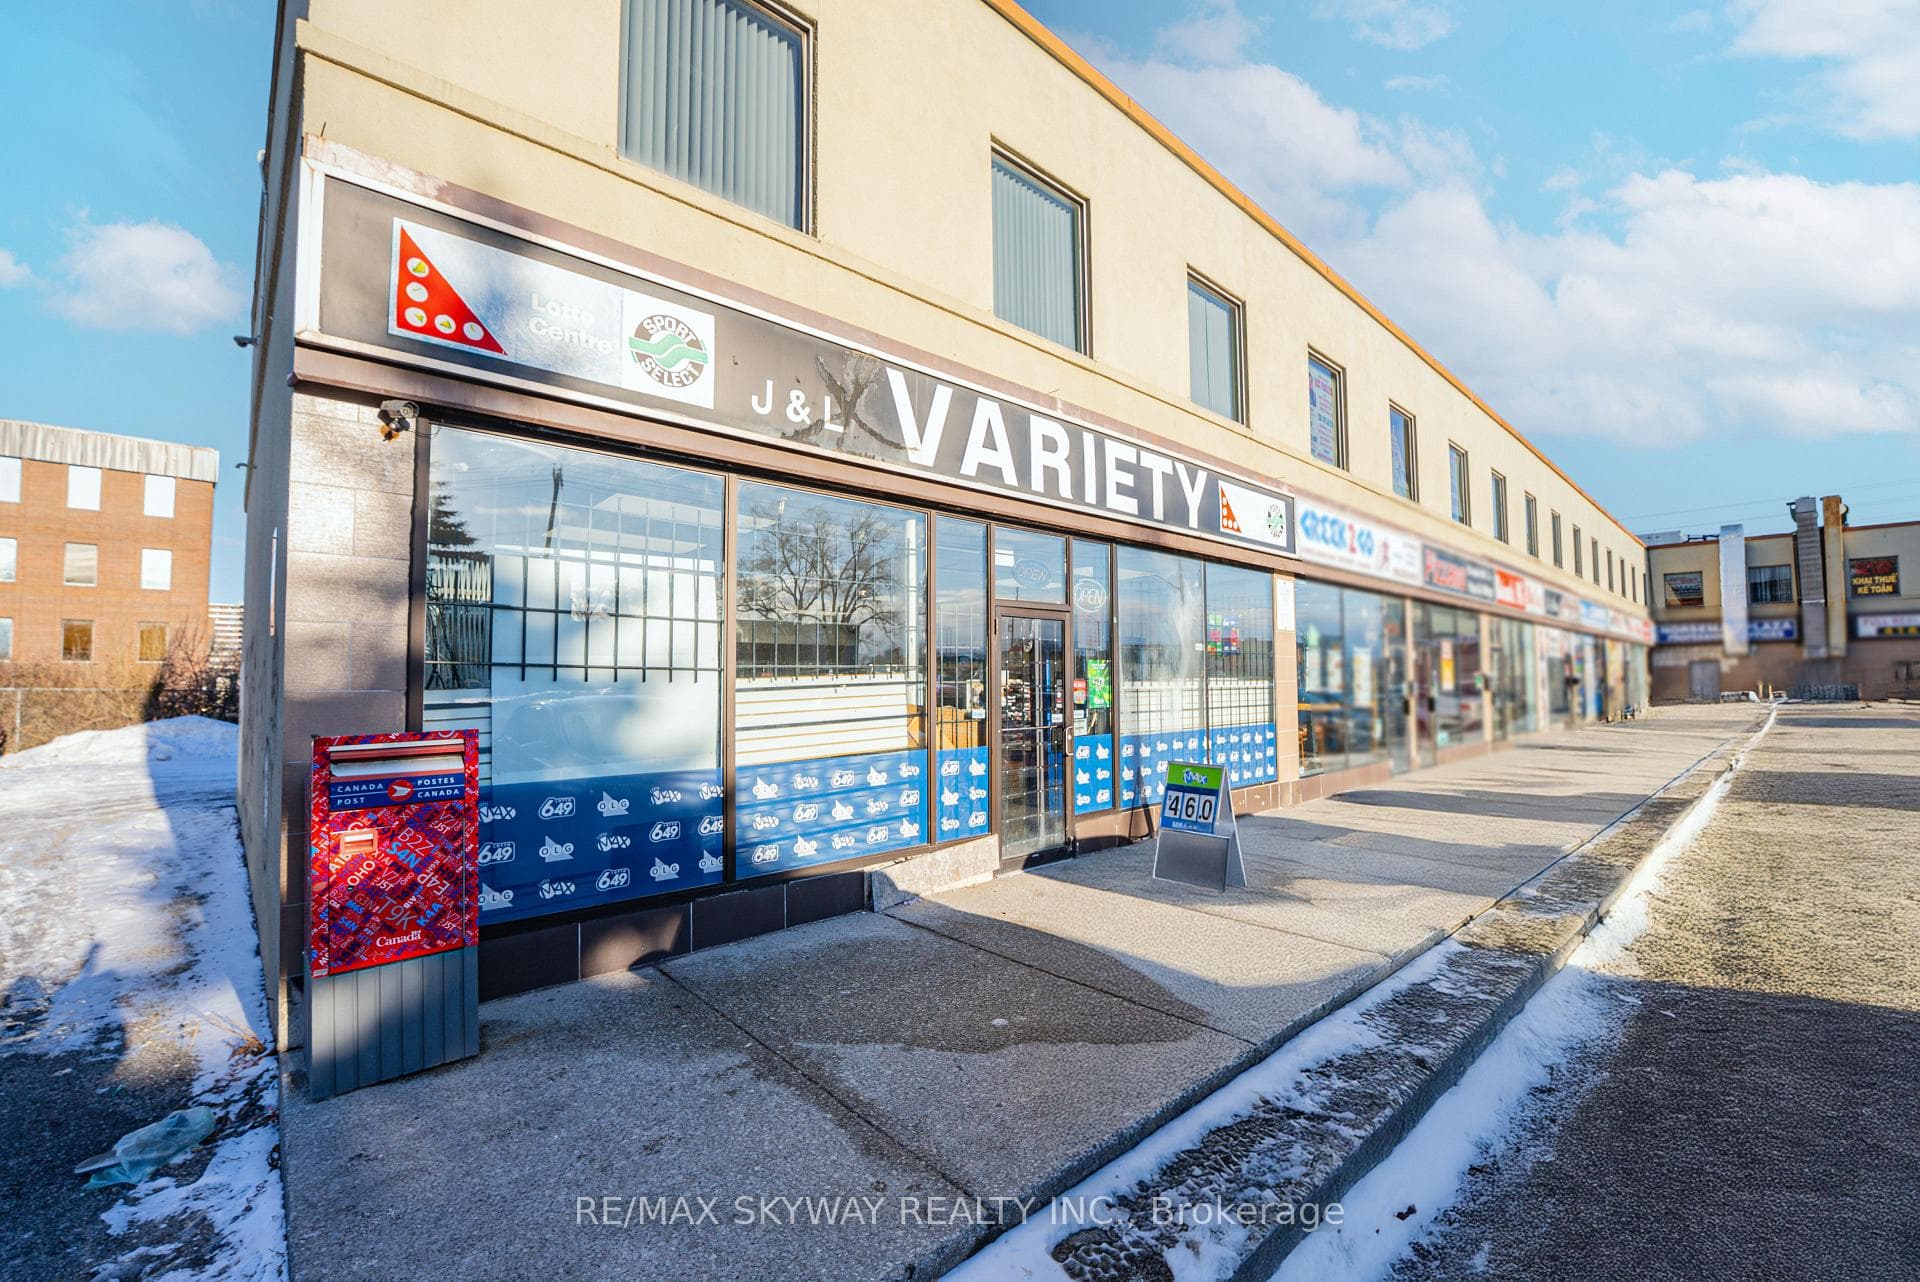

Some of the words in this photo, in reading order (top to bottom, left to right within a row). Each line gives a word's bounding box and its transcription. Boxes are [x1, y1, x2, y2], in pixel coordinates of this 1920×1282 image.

[529, 316, 612, 354] Centre
[642, 315, 697, 343] SPORT
[641, 357, 700, 387] SELECT
[751, 379, 774, 416] J
[786, 390, 812, 424] &
[825, 396, 845, 432] L
[886, 367, 1208, 530] VARIETY
[337, 783, 384, 793] CANADA
[417, 777, 455, 786] POSTES
[417, 788, 460, 798] CANADA
[337, 797, 366, 806] POST
[541, 800, 573, 818] 649
[597, 799, 630, 812] OLG
[652, 823, 678, 840] 649
[478, 845, 512, 863] 649
[539, 843, 574, 857] OLG
[650, 863, 680, 877] OLG
[599, 872, 628, 889] 649
[376, 931, 421, 947] Canada
